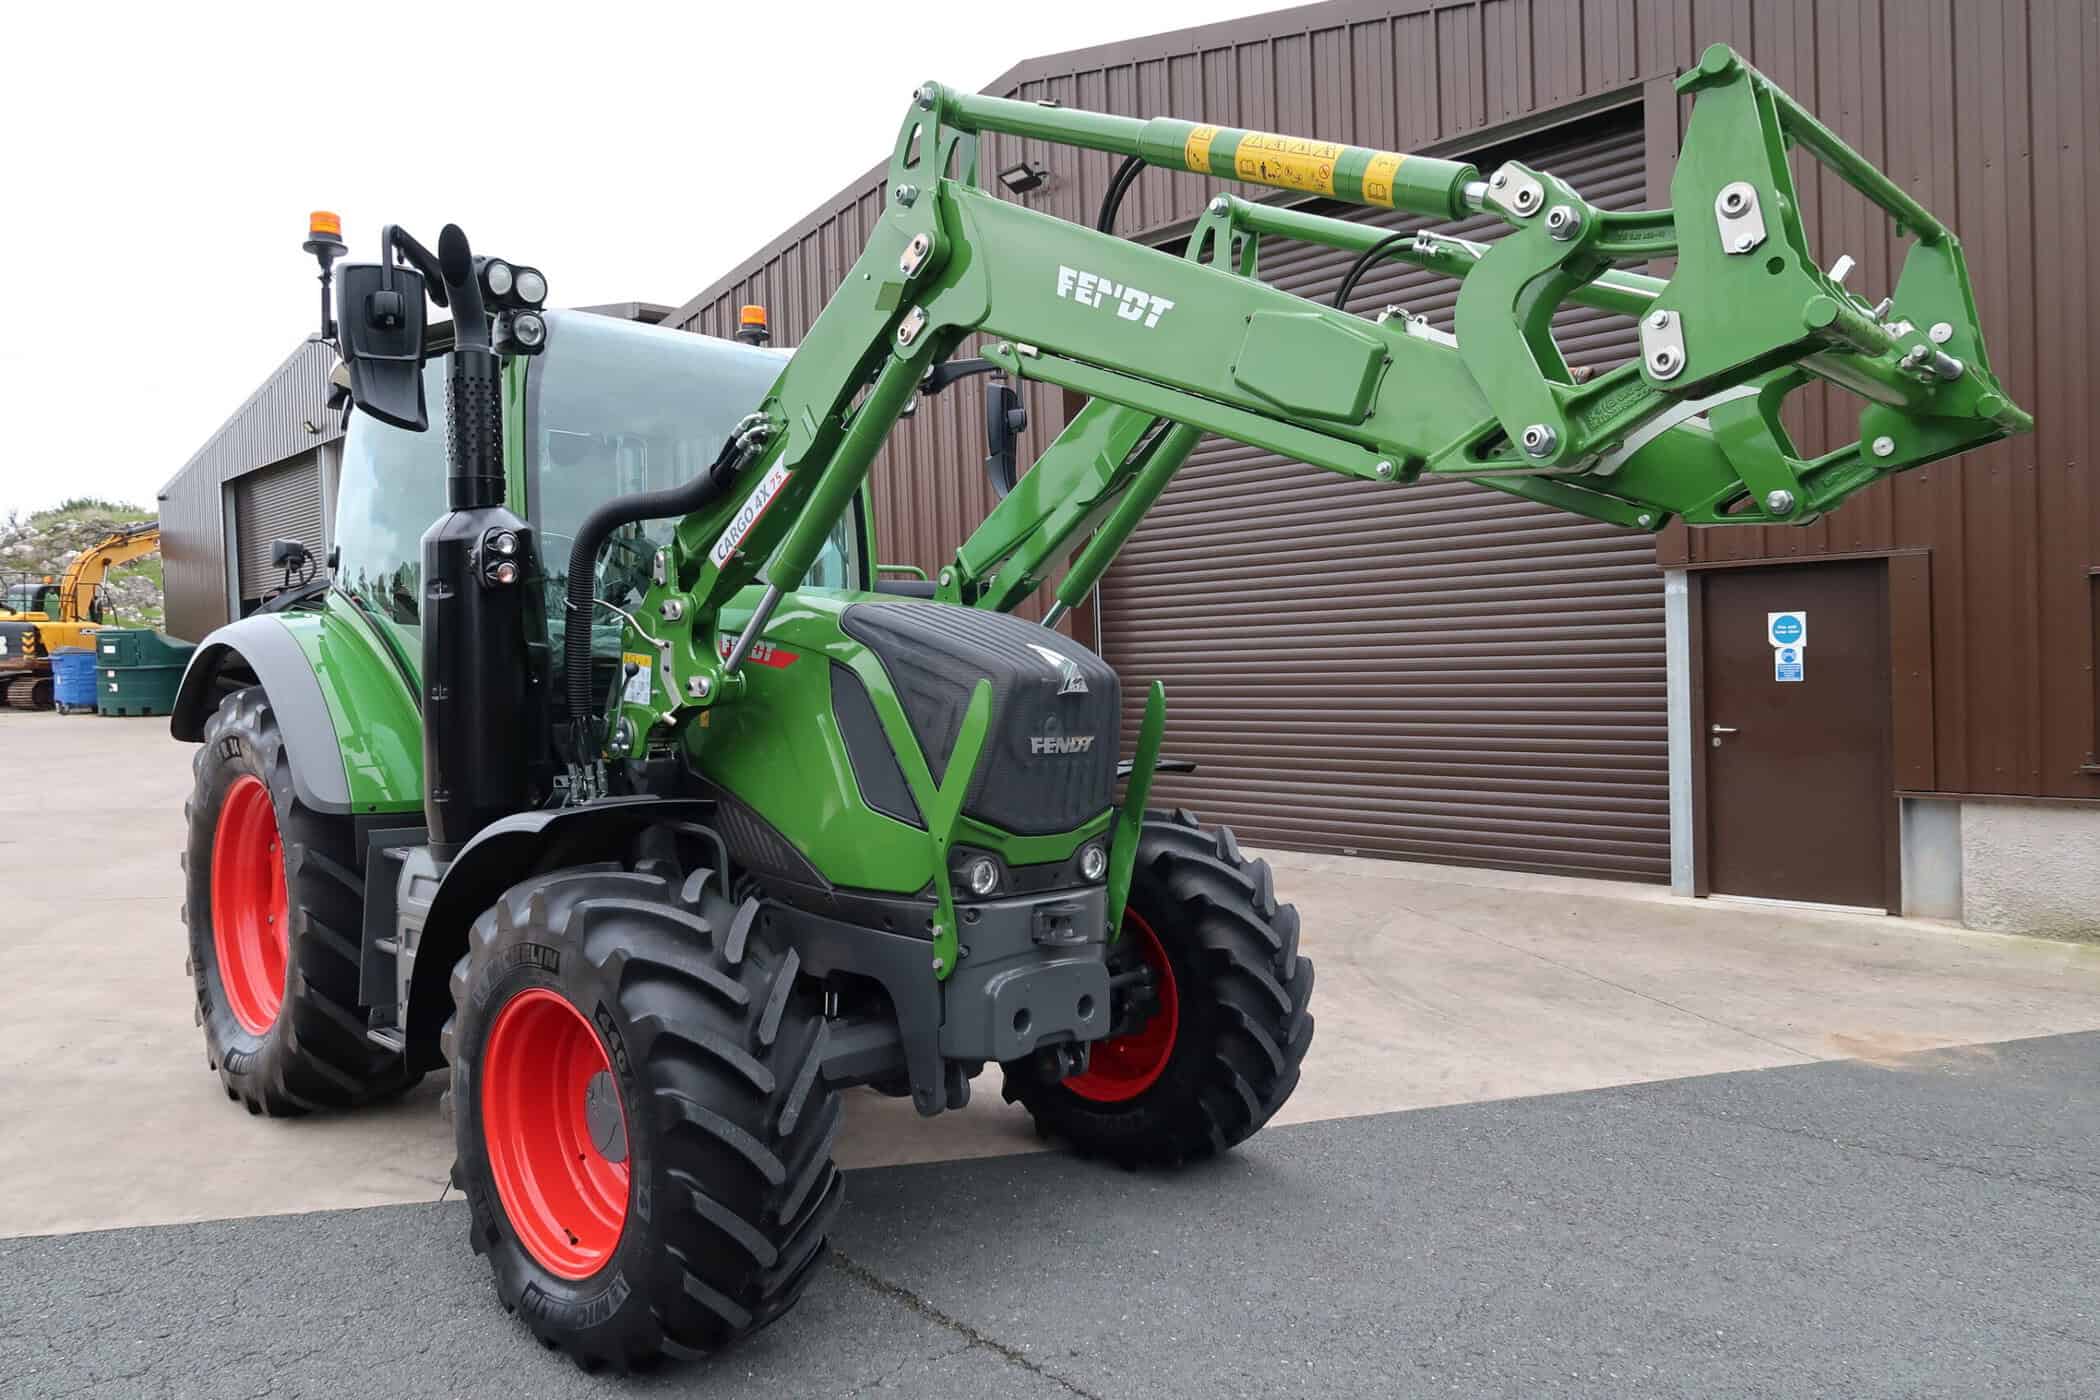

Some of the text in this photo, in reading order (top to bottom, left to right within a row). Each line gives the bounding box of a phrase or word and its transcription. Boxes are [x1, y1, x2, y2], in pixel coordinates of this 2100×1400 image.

[1056, 264, 1175, 328] FENDT
[717, 507, 754, 560] CARGO
[1030, 736, 1095, 754] FENDT
